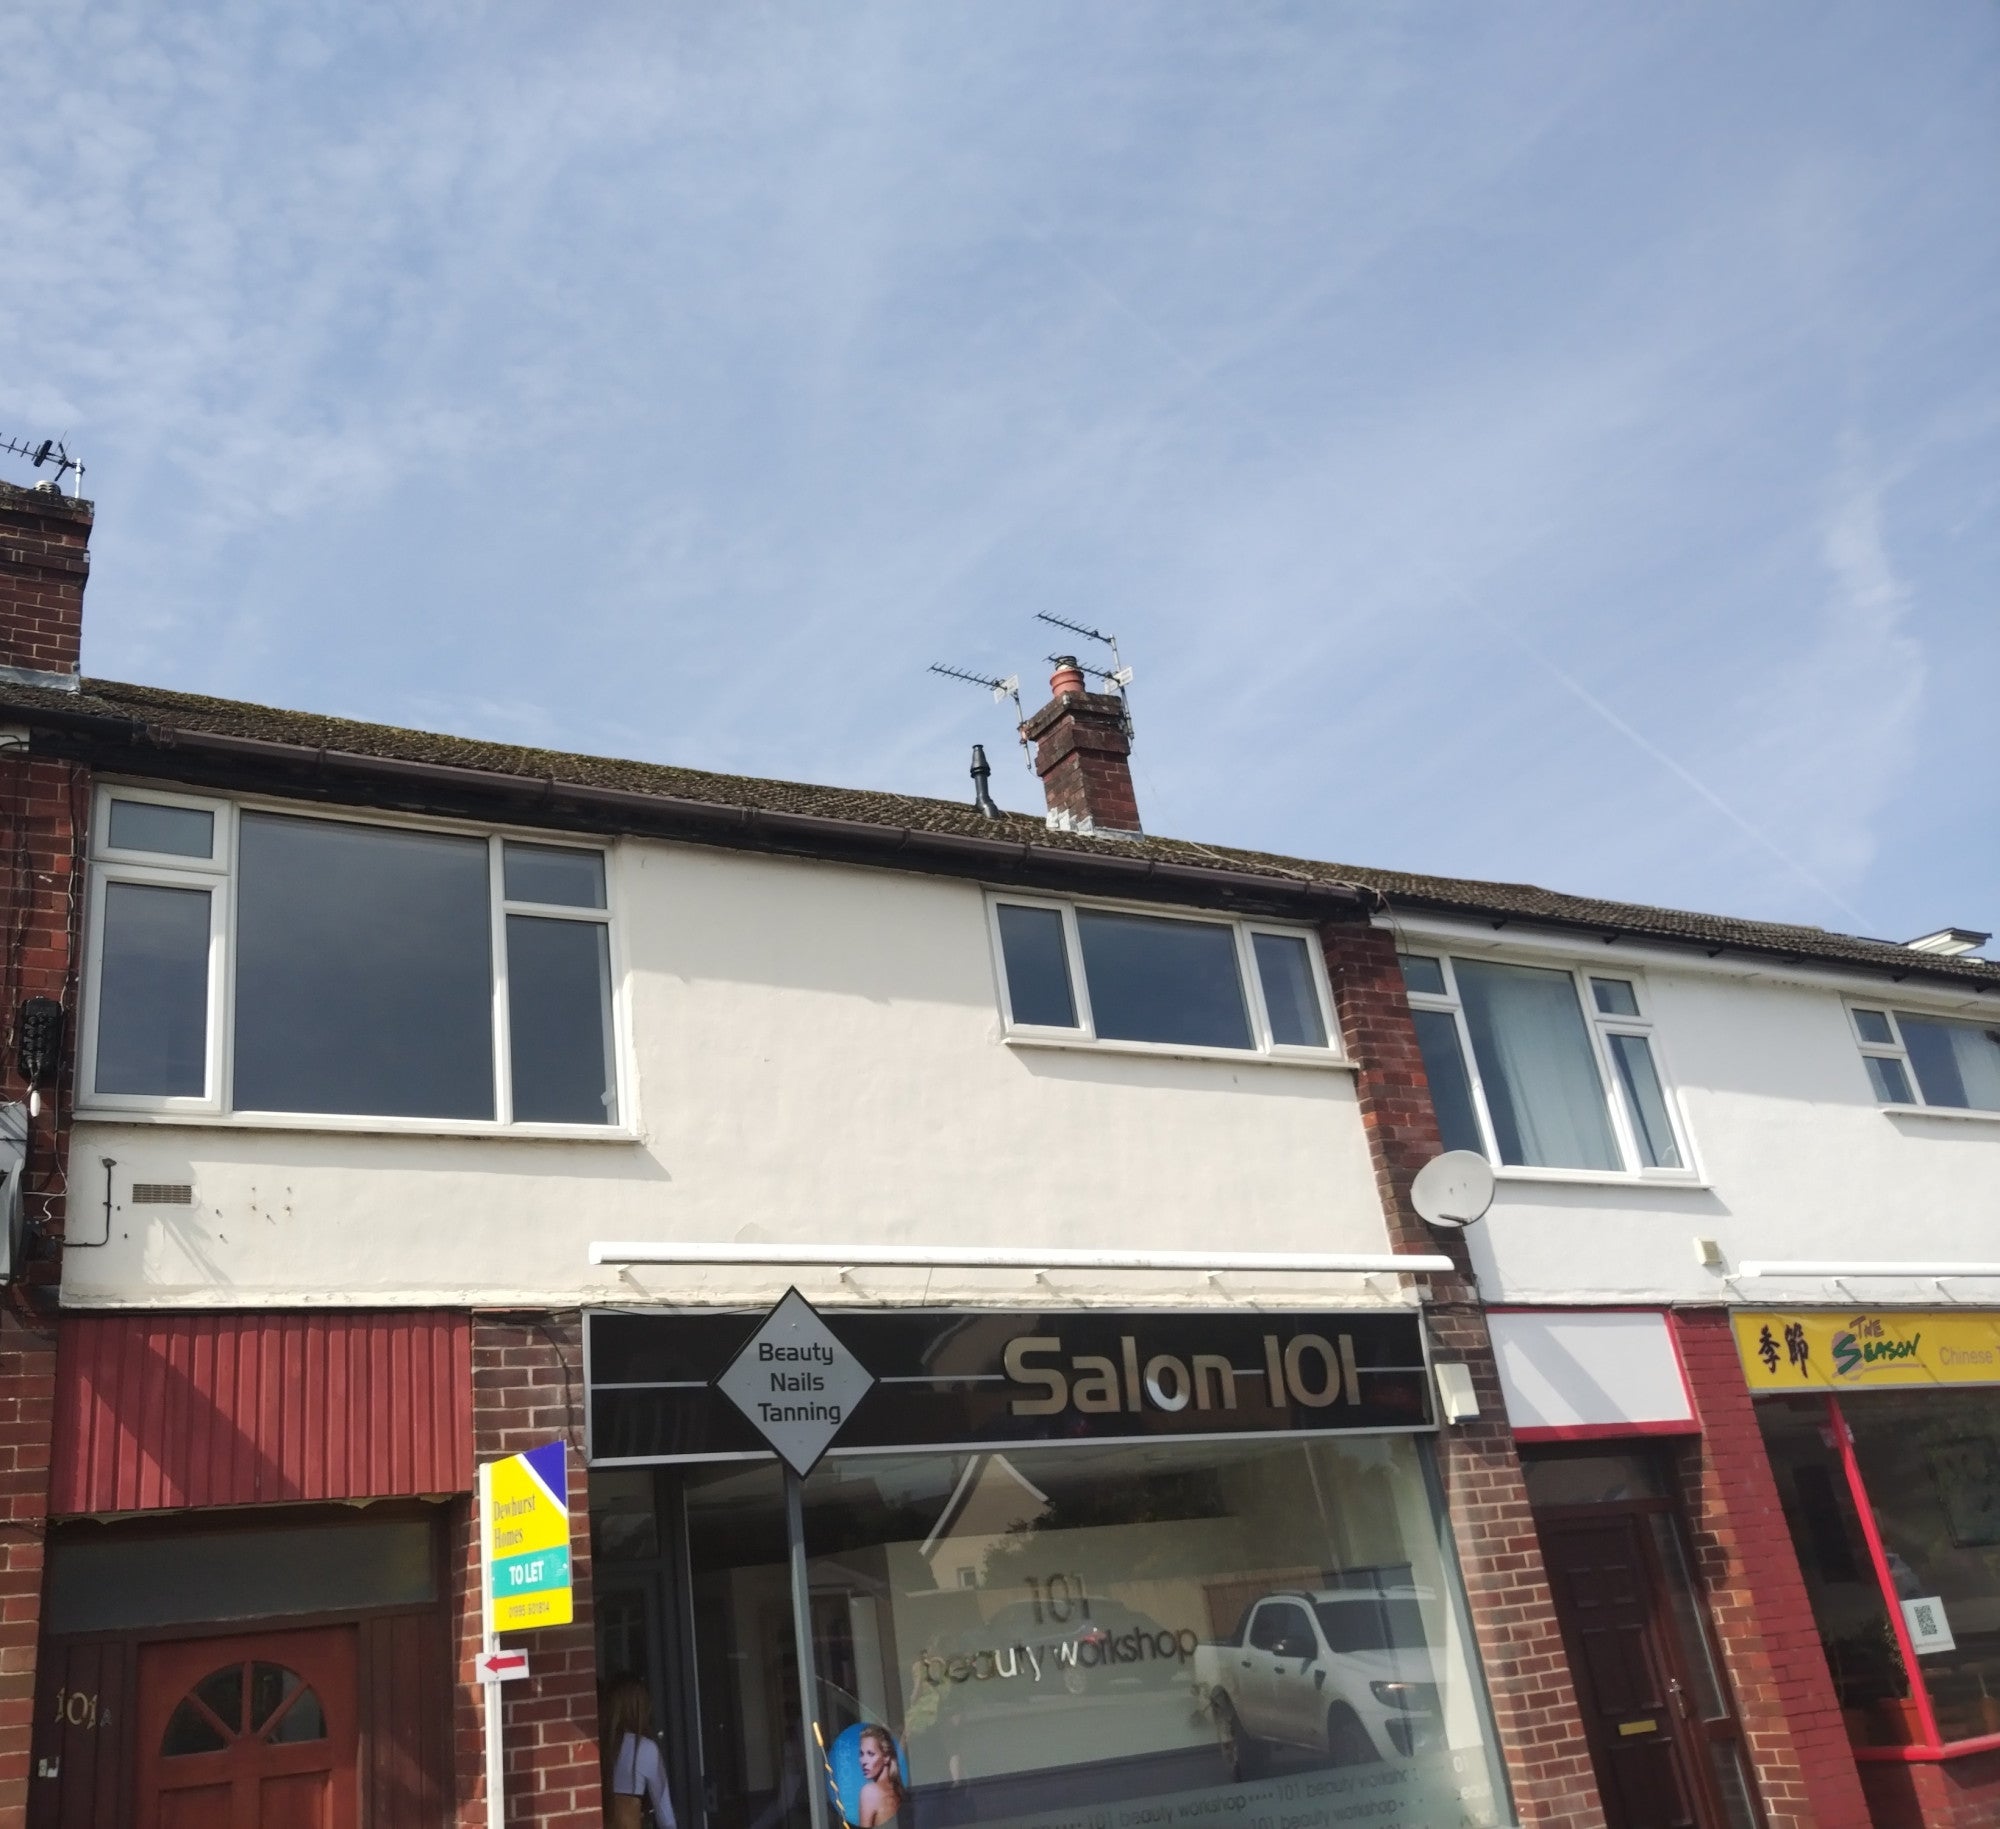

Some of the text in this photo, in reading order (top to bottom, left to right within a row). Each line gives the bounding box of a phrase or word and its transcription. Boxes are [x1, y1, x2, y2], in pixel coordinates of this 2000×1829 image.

[1850, 1315, 1885, 1339] THE
[759, 1343, 834, 1366] Beauty
[1758, 1322, 1808, 1378] 季節
[1833, 1333, 1921, 1375] SEASON
[1938, 1345, 1993, 1366] Chinese
[770, 1372, 825, 1392] Nails
[1004, 1334, 1361, 1416] Salon 101
[758, 1402, 841, 1425] Tanning
[493, 1494, 536, 1522] Dewhurst
[494, 1527, 524, 1550] Homes
[509, 1560, 545, 1586] TO LET
[1024, 1572, 1090, 1625] 101
[920, 1626, 1199, 1687] beauty workshop
